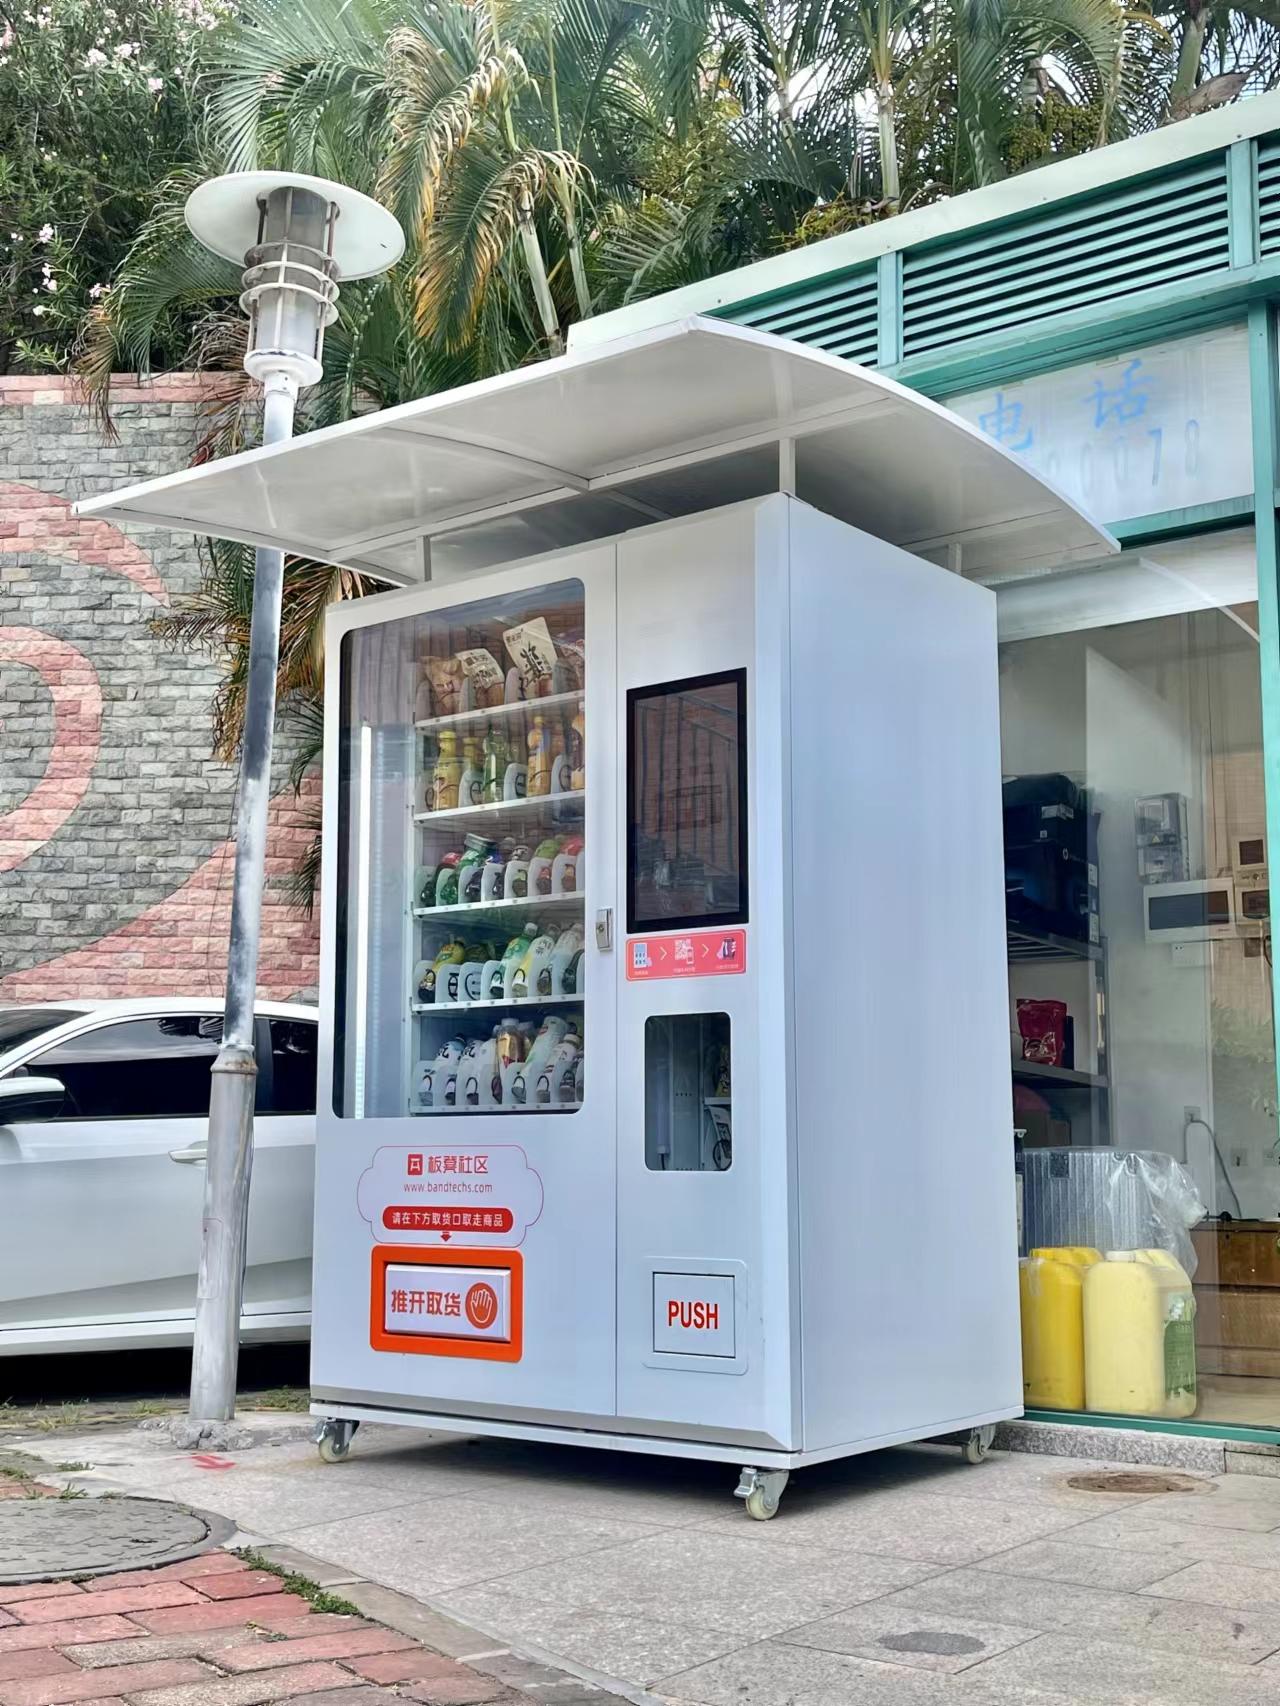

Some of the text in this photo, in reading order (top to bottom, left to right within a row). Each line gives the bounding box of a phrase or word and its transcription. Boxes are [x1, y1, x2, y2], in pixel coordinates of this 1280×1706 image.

[427, 1155, 489, 1175] 板凳社区
[404, 1181, 493, 1193] www.bandtechs.com
[391, 1211, 505, 1228] 请在下方取货口取走商品
[390, 1289, 462, 1317] 推开取货
[668, 1300, 719, 1330] PUSH
